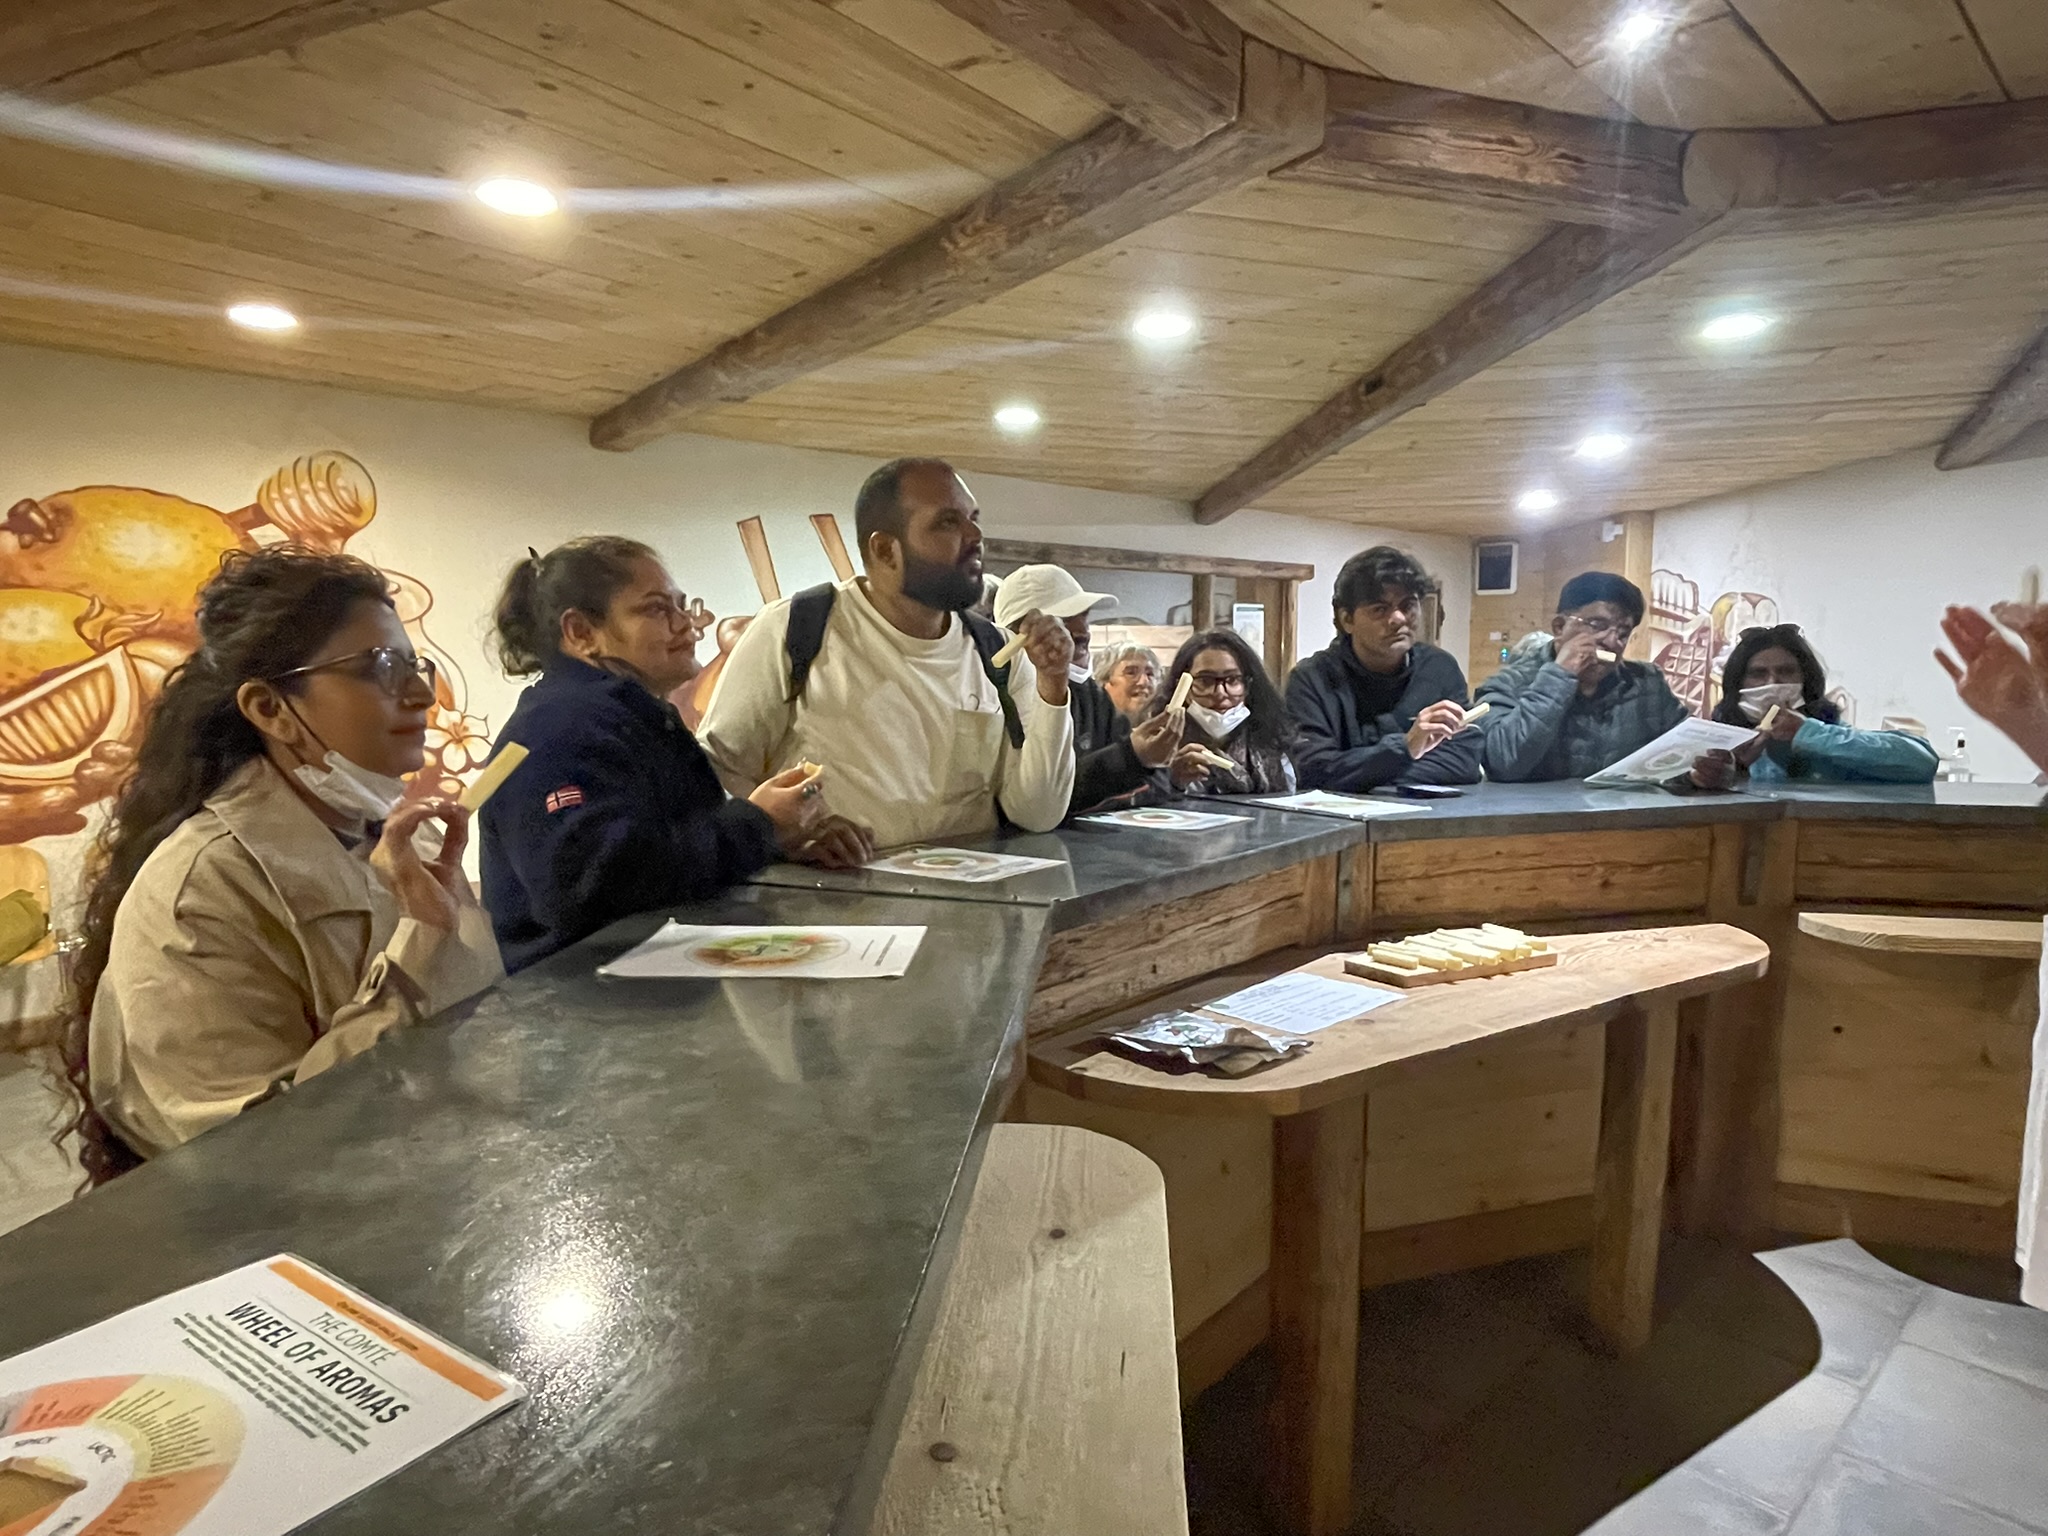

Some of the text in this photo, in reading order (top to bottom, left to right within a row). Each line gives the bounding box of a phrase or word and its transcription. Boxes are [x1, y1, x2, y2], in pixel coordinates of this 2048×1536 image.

[225, 1301, 298, 1349] WHEEL
[284, 1341, 328, 1363] OF
[307, 1360, 410, 1423] AROMAS
[309, 1312, 347, 1334] THE
[335, 1328, 401, 1366] COMTÉ
